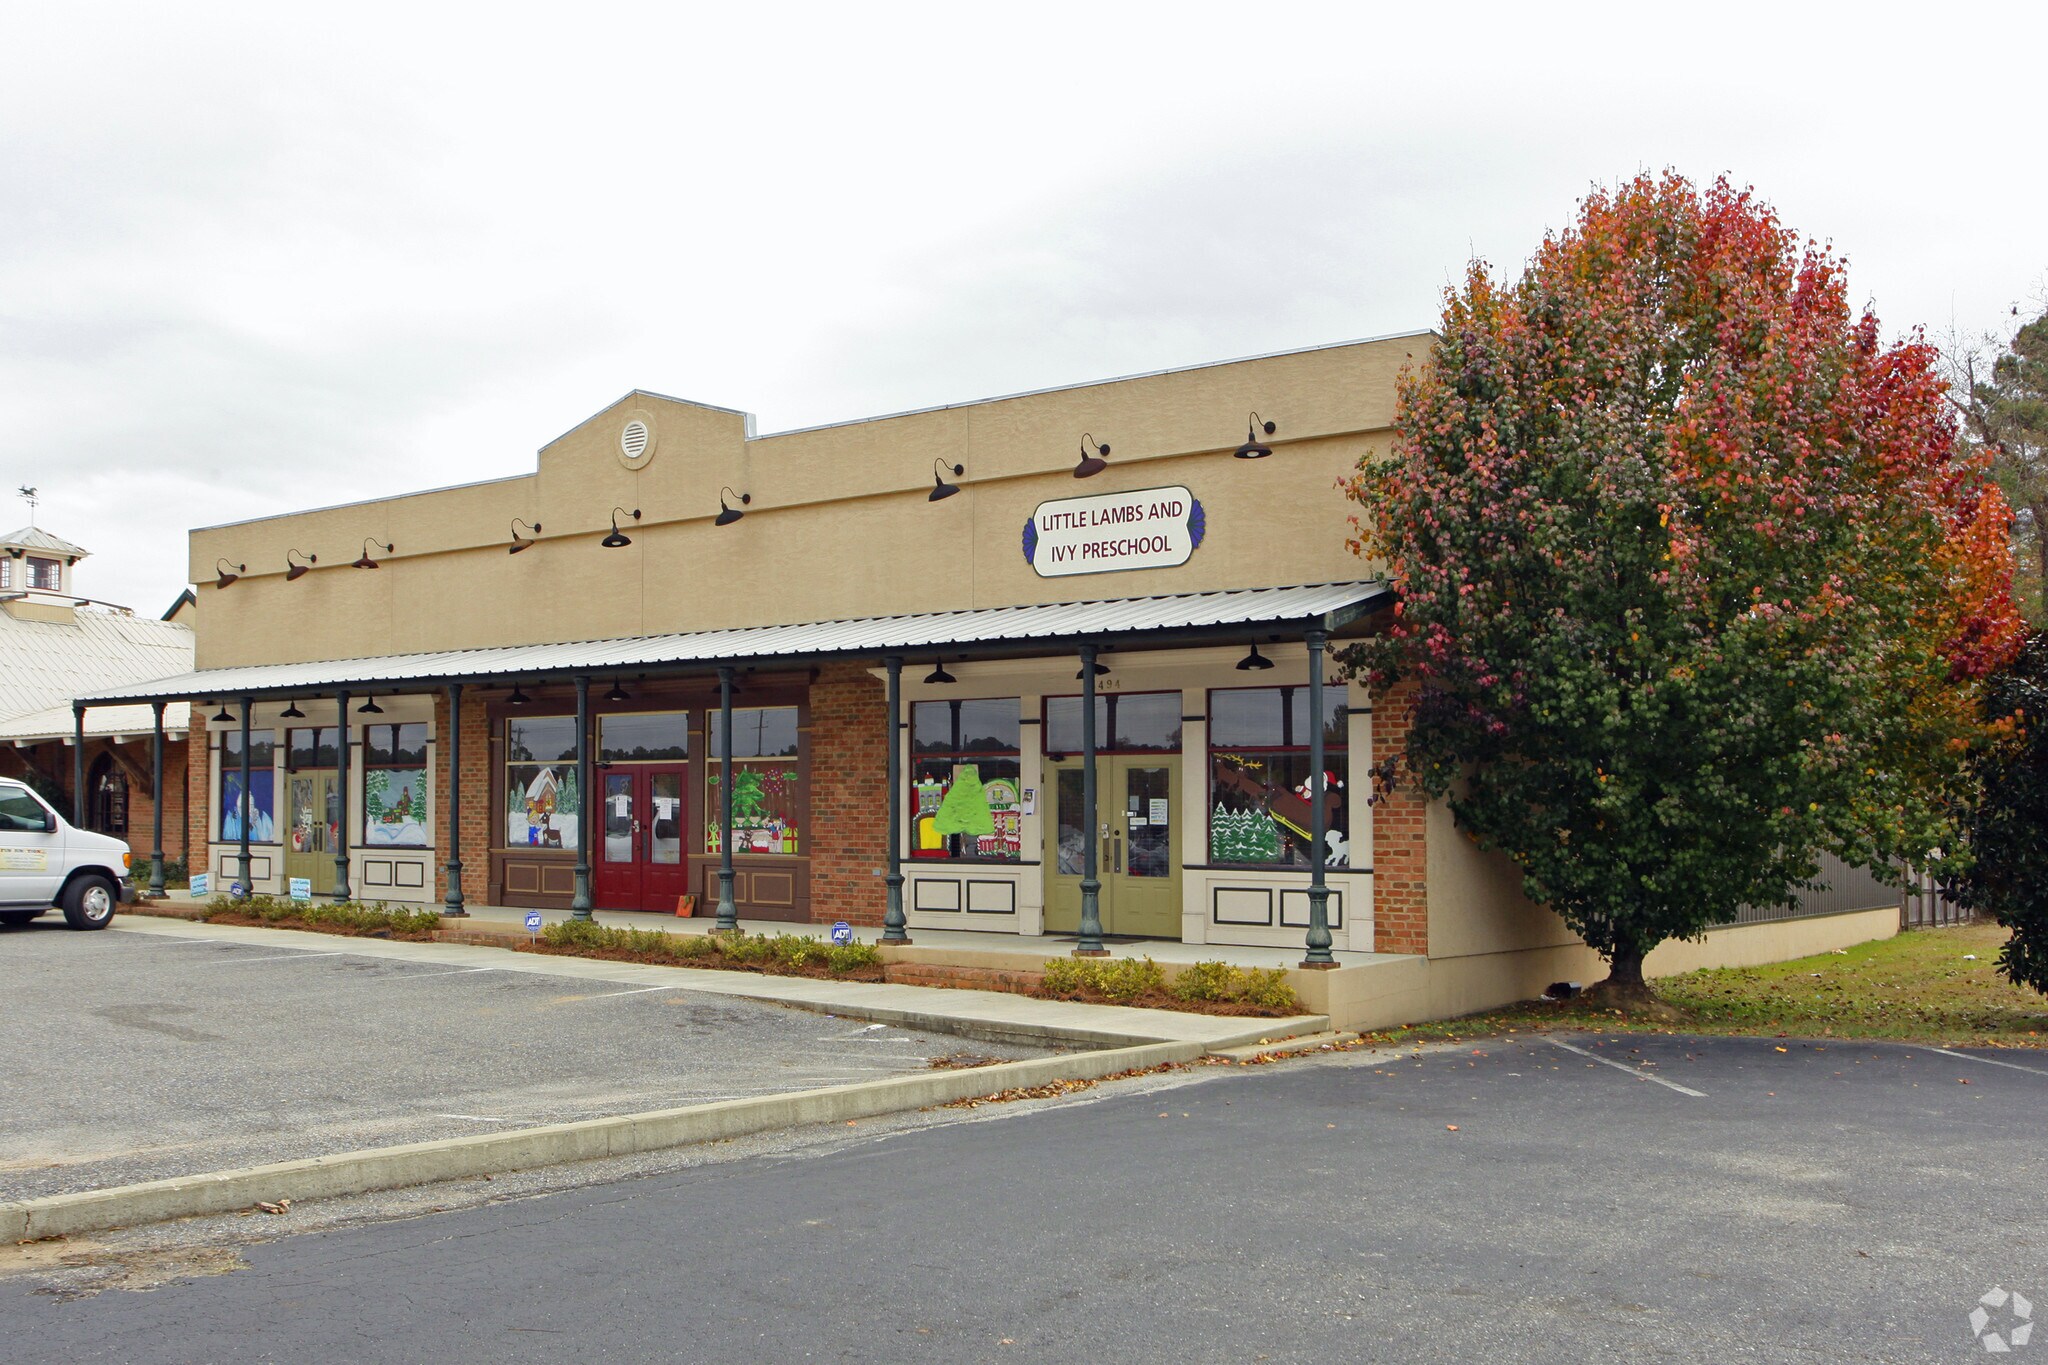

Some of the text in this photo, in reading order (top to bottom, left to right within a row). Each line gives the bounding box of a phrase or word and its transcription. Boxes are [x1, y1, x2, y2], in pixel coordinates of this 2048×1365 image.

[1043, 501, 1183, 531] LITTLE LAMBS AND
[1051, 535, 1172, 562] IVY PRESCHOOL
[1098, 679, 1120, 690] 494
[527, 917, 539, 926] ADT
[834, 929, 849, 939] ADT
